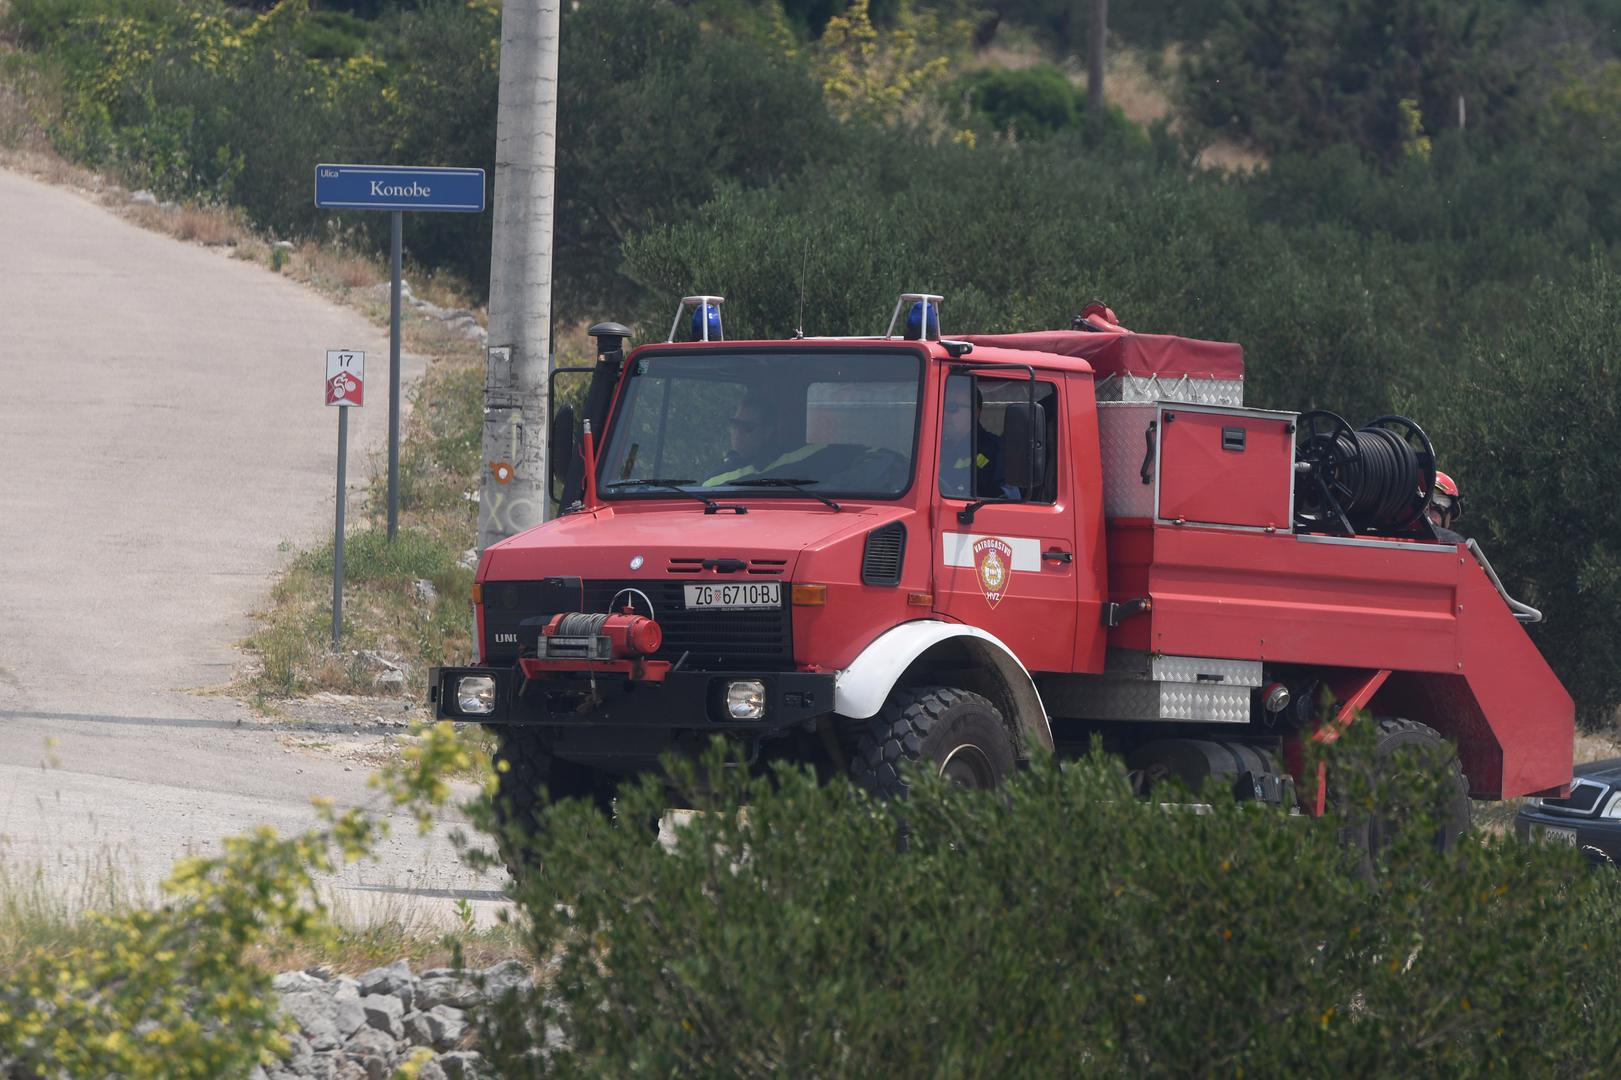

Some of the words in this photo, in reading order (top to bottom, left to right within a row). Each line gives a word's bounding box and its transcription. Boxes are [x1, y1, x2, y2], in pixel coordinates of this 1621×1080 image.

[320, 168, 339, 178] Ulica
[370, 180, 431, 198] Konobe
[337, 354, 354, 368] 17
[973, 539, 1012, 557] VATROGASTVO
[694, 586, 713, 605] ZG
[986, 591, 1000, 601] HVZ
